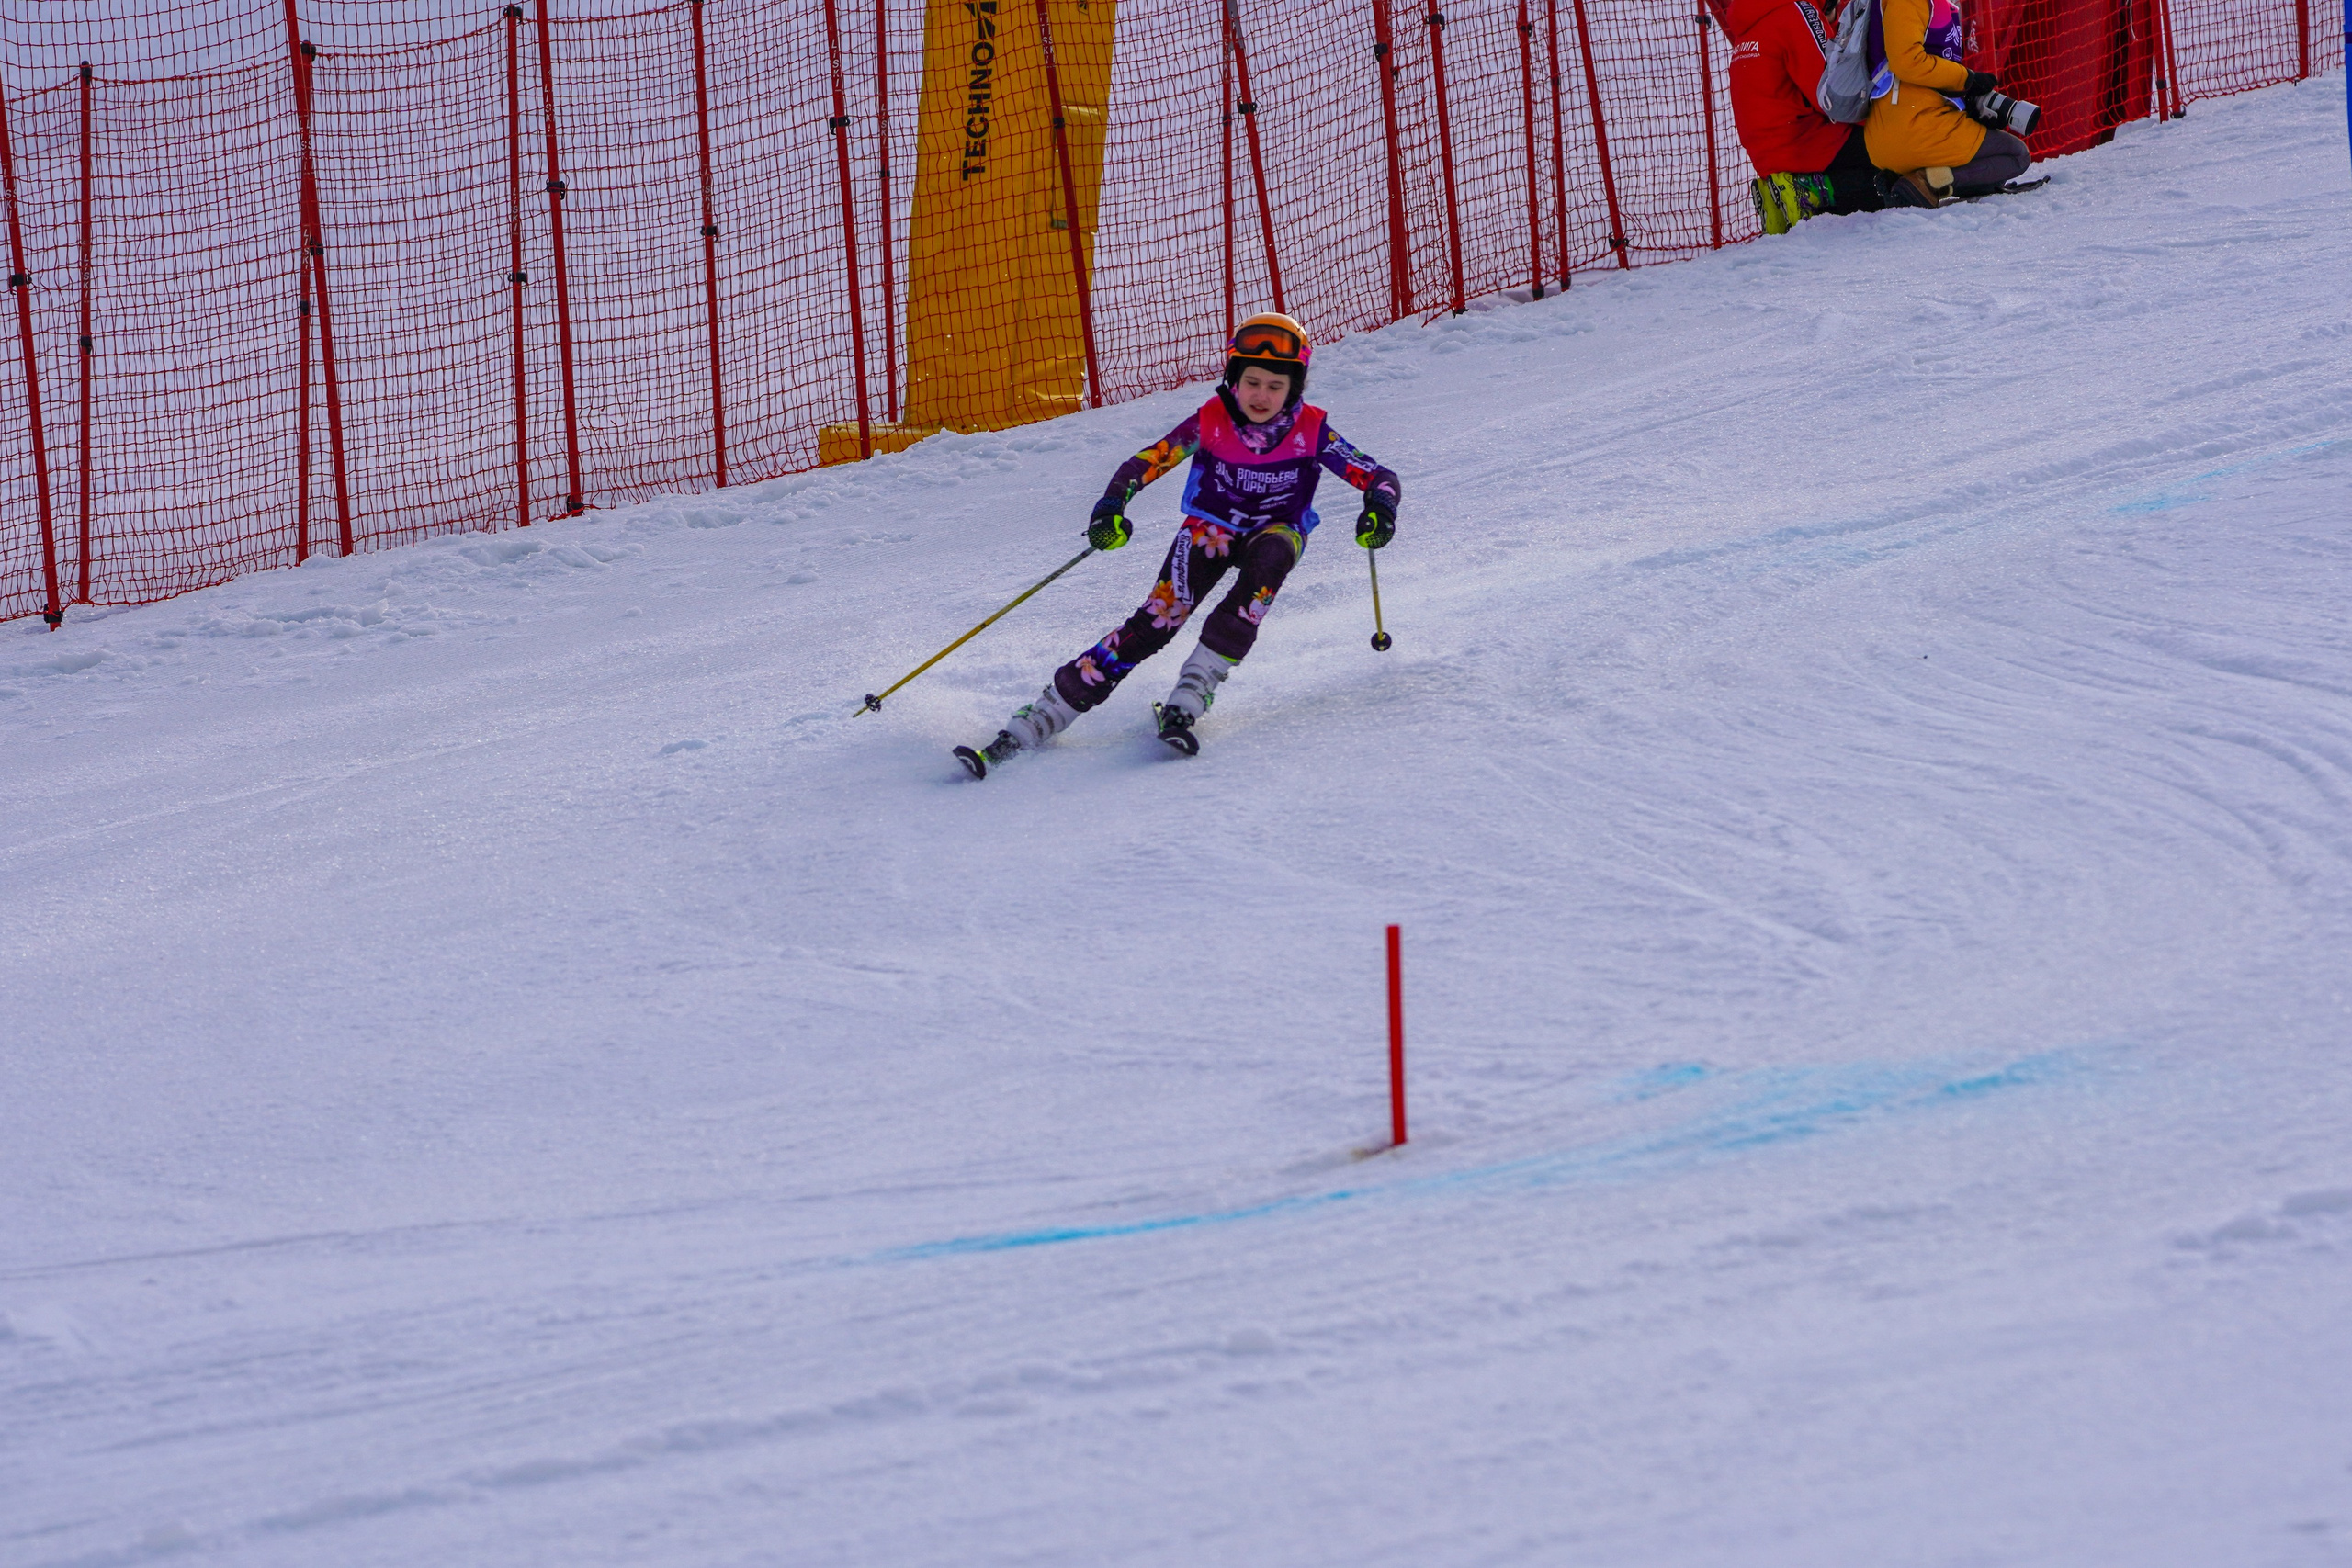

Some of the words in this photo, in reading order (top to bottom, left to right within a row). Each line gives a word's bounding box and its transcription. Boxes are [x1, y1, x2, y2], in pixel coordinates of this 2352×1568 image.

[831, 39, 840, 87] LISKI
[544, 85, 552, 132] LISKI
[1236, 479, 1266, 493] ГОРЫ
